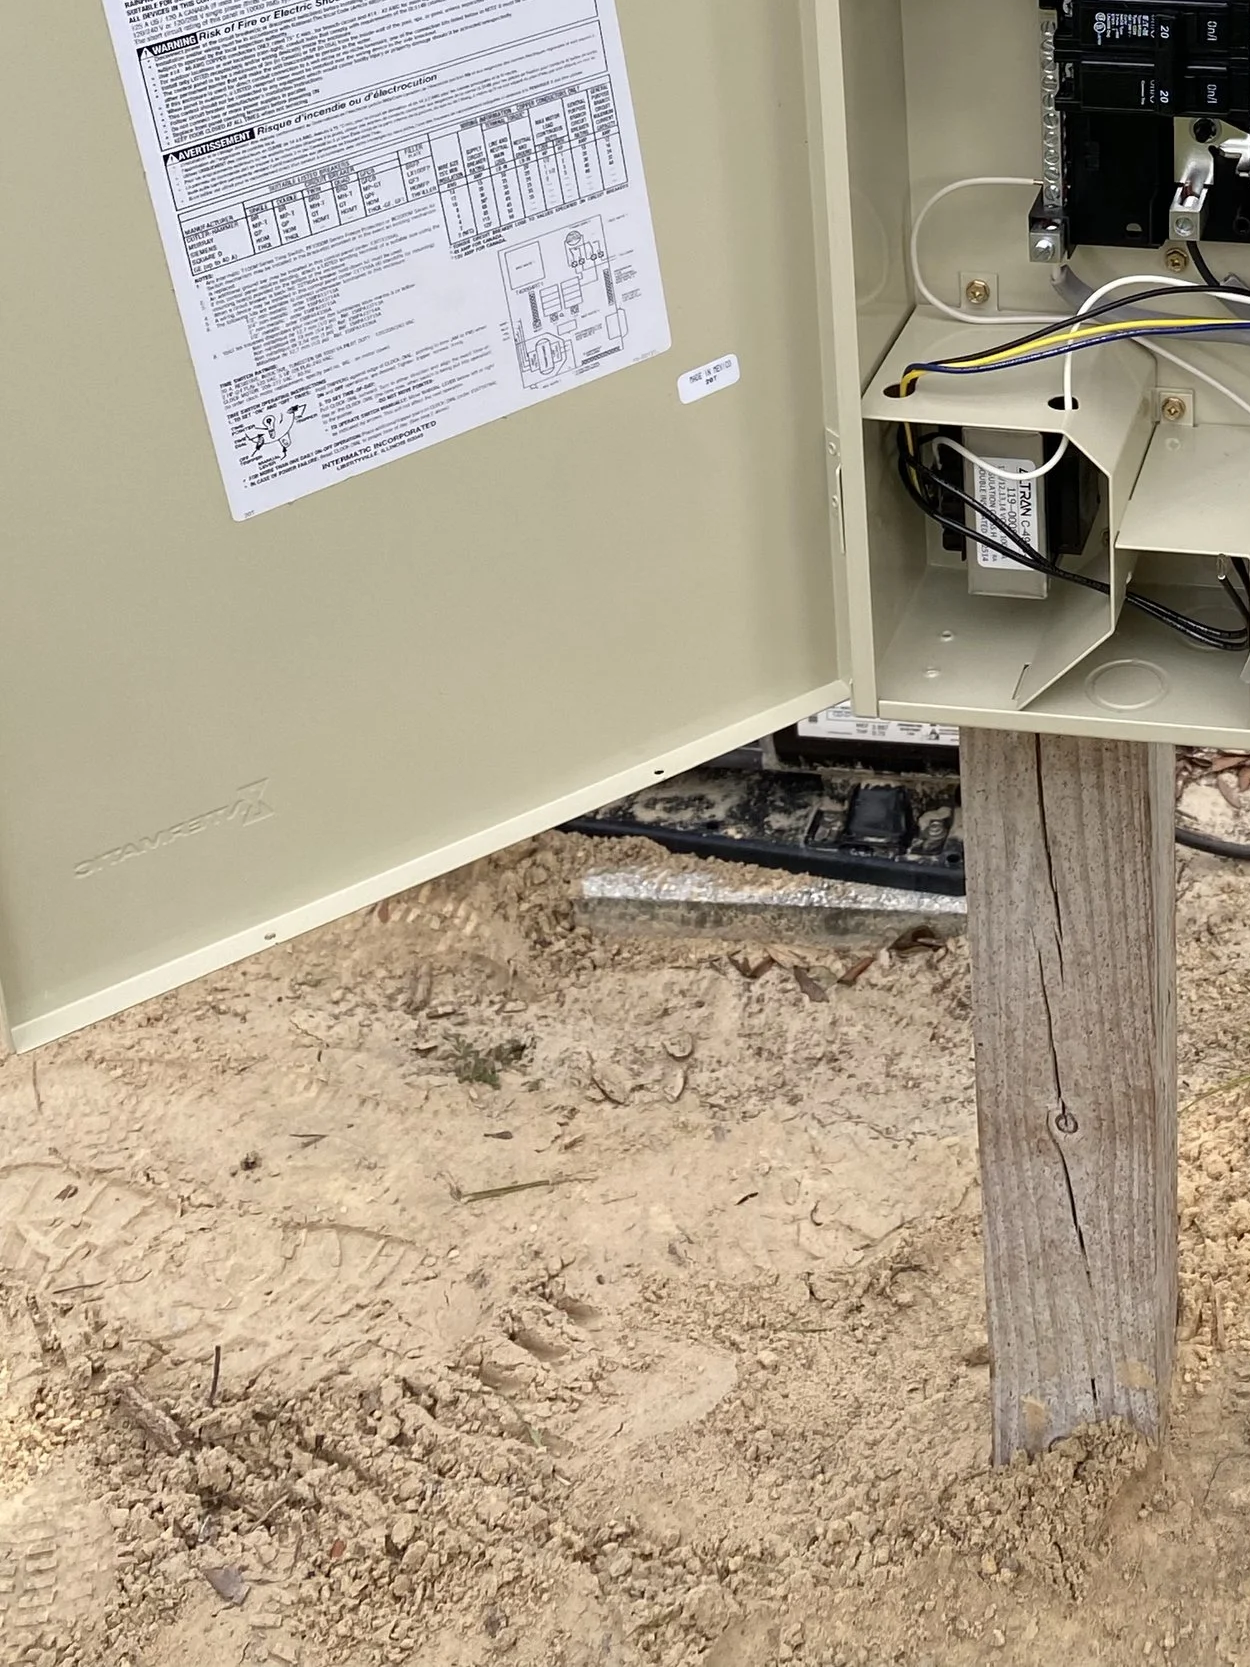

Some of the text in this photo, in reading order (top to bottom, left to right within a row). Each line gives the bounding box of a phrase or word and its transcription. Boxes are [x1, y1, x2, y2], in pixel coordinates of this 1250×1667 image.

[198, 27, 220, 41] Risk
[223, 23, 236, 34] of
[237, 17, 256, 30] Fire
[258, 14, 271, 24] or
[273, 0, 312, 20] Electric
[1160, 25, 1169, 39] 20
[151, 34, 197, 56] WARNING
[1160, 90, 1169, 103] 20
[256, 118, 292, 137] Risque
[293, 99, 346, 124] d'incendie
[348, 96, 362, 107] ou
[177, 130, 251, 161] AVERTISSEMENT
[689, 372, 703, 384] MADE
[321, 419, 436, 471] INTERMATIC INCORPORATED
